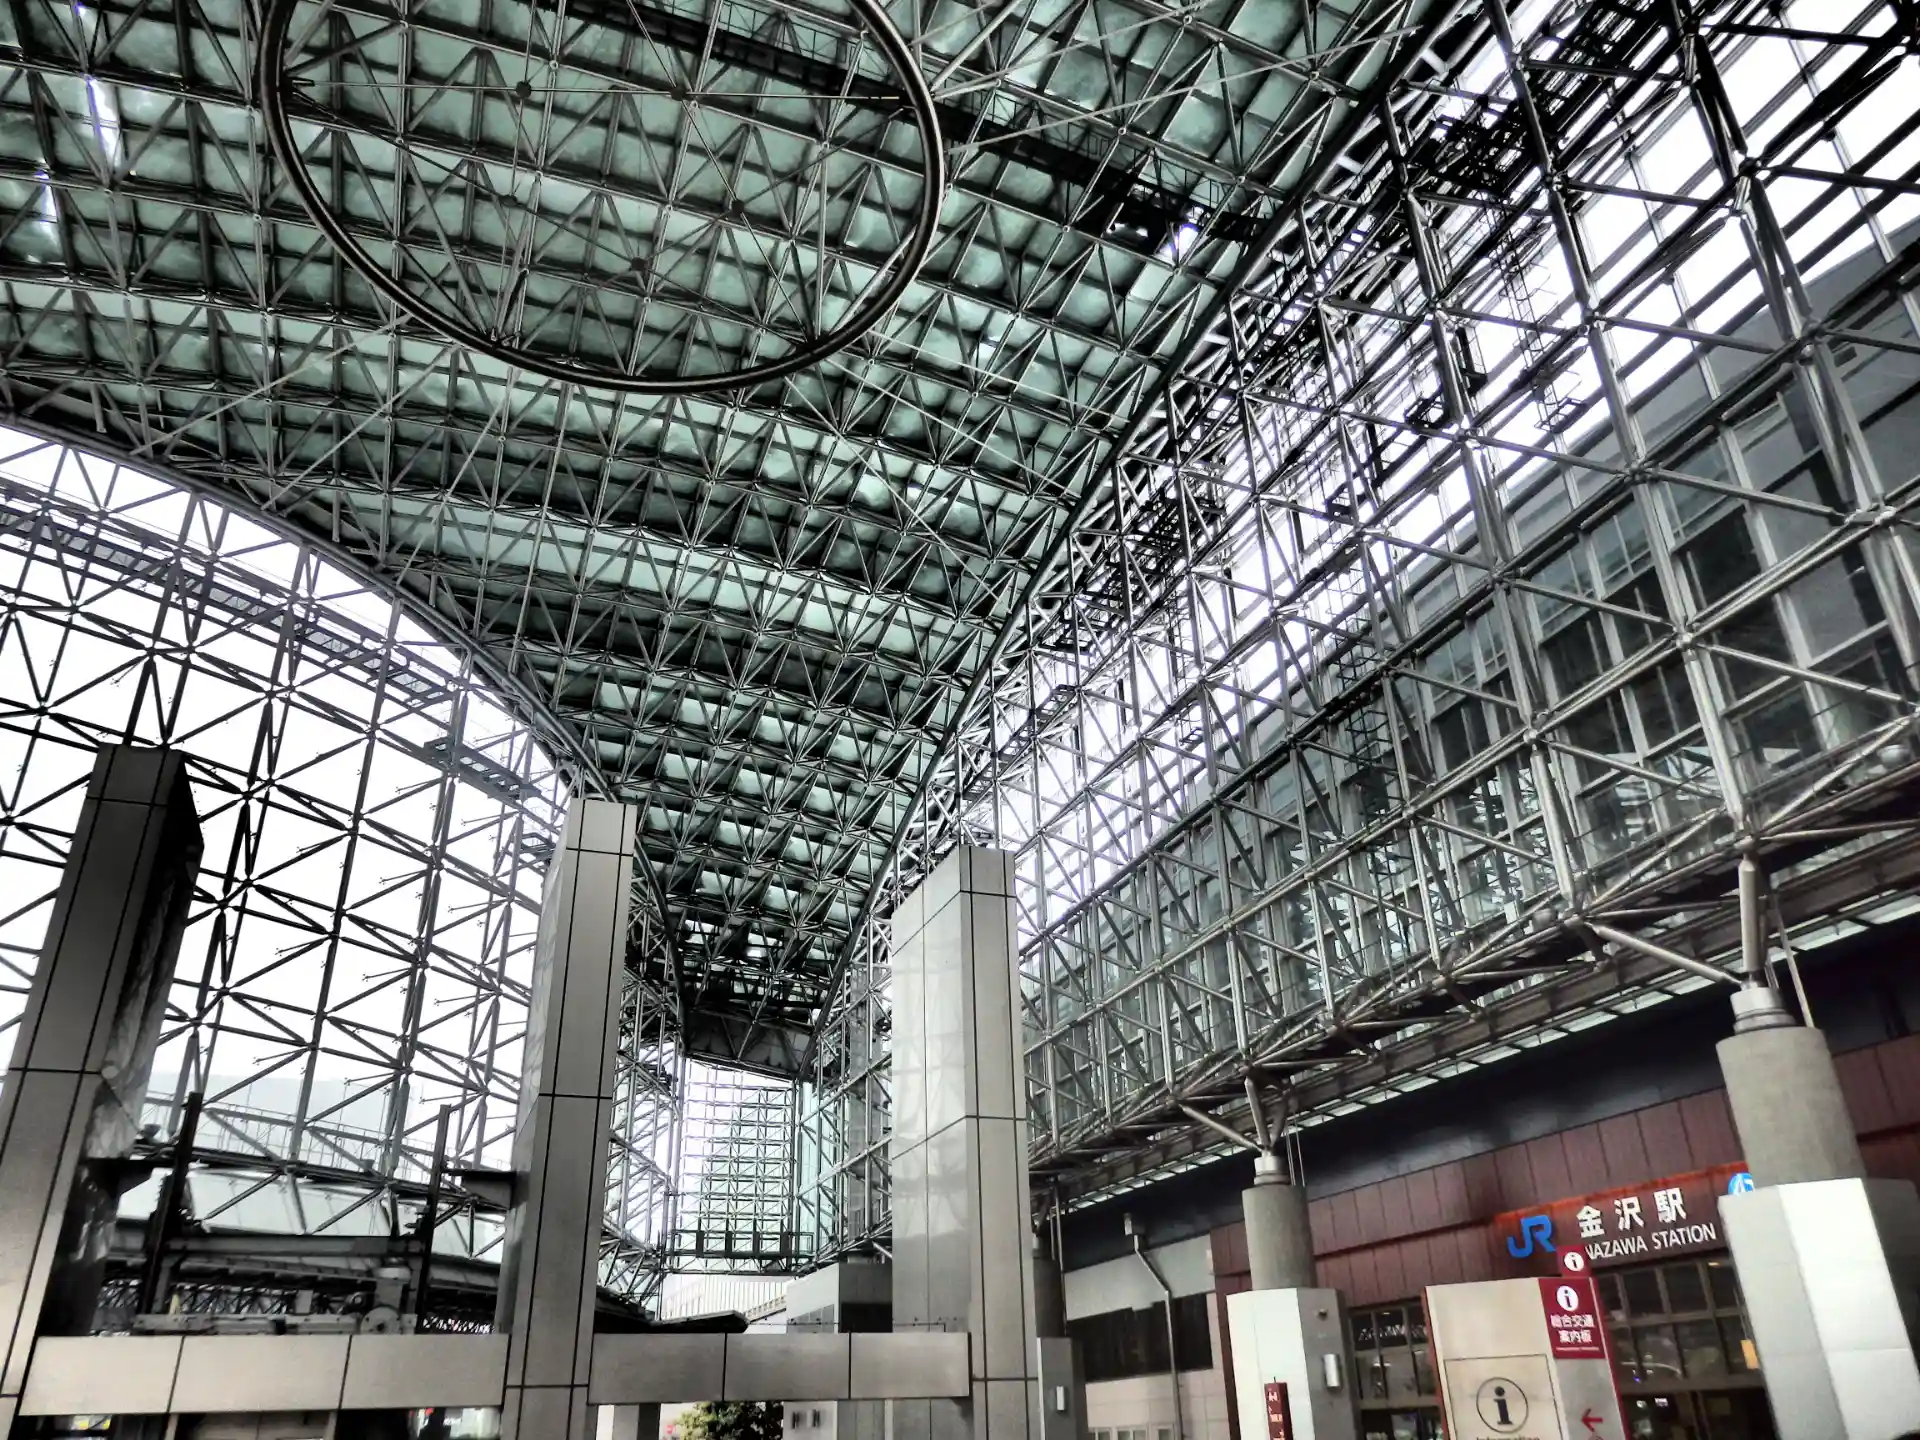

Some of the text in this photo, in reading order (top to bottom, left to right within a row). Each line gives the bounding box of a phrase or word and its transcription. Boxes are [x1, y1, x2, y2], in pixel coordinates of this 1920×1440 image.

[1576, 1187, 1687, 1238] 金沢駅
[1507, 1215, 1557, 1259] JR
[1651, 1222, 1717, 1250] STATION
